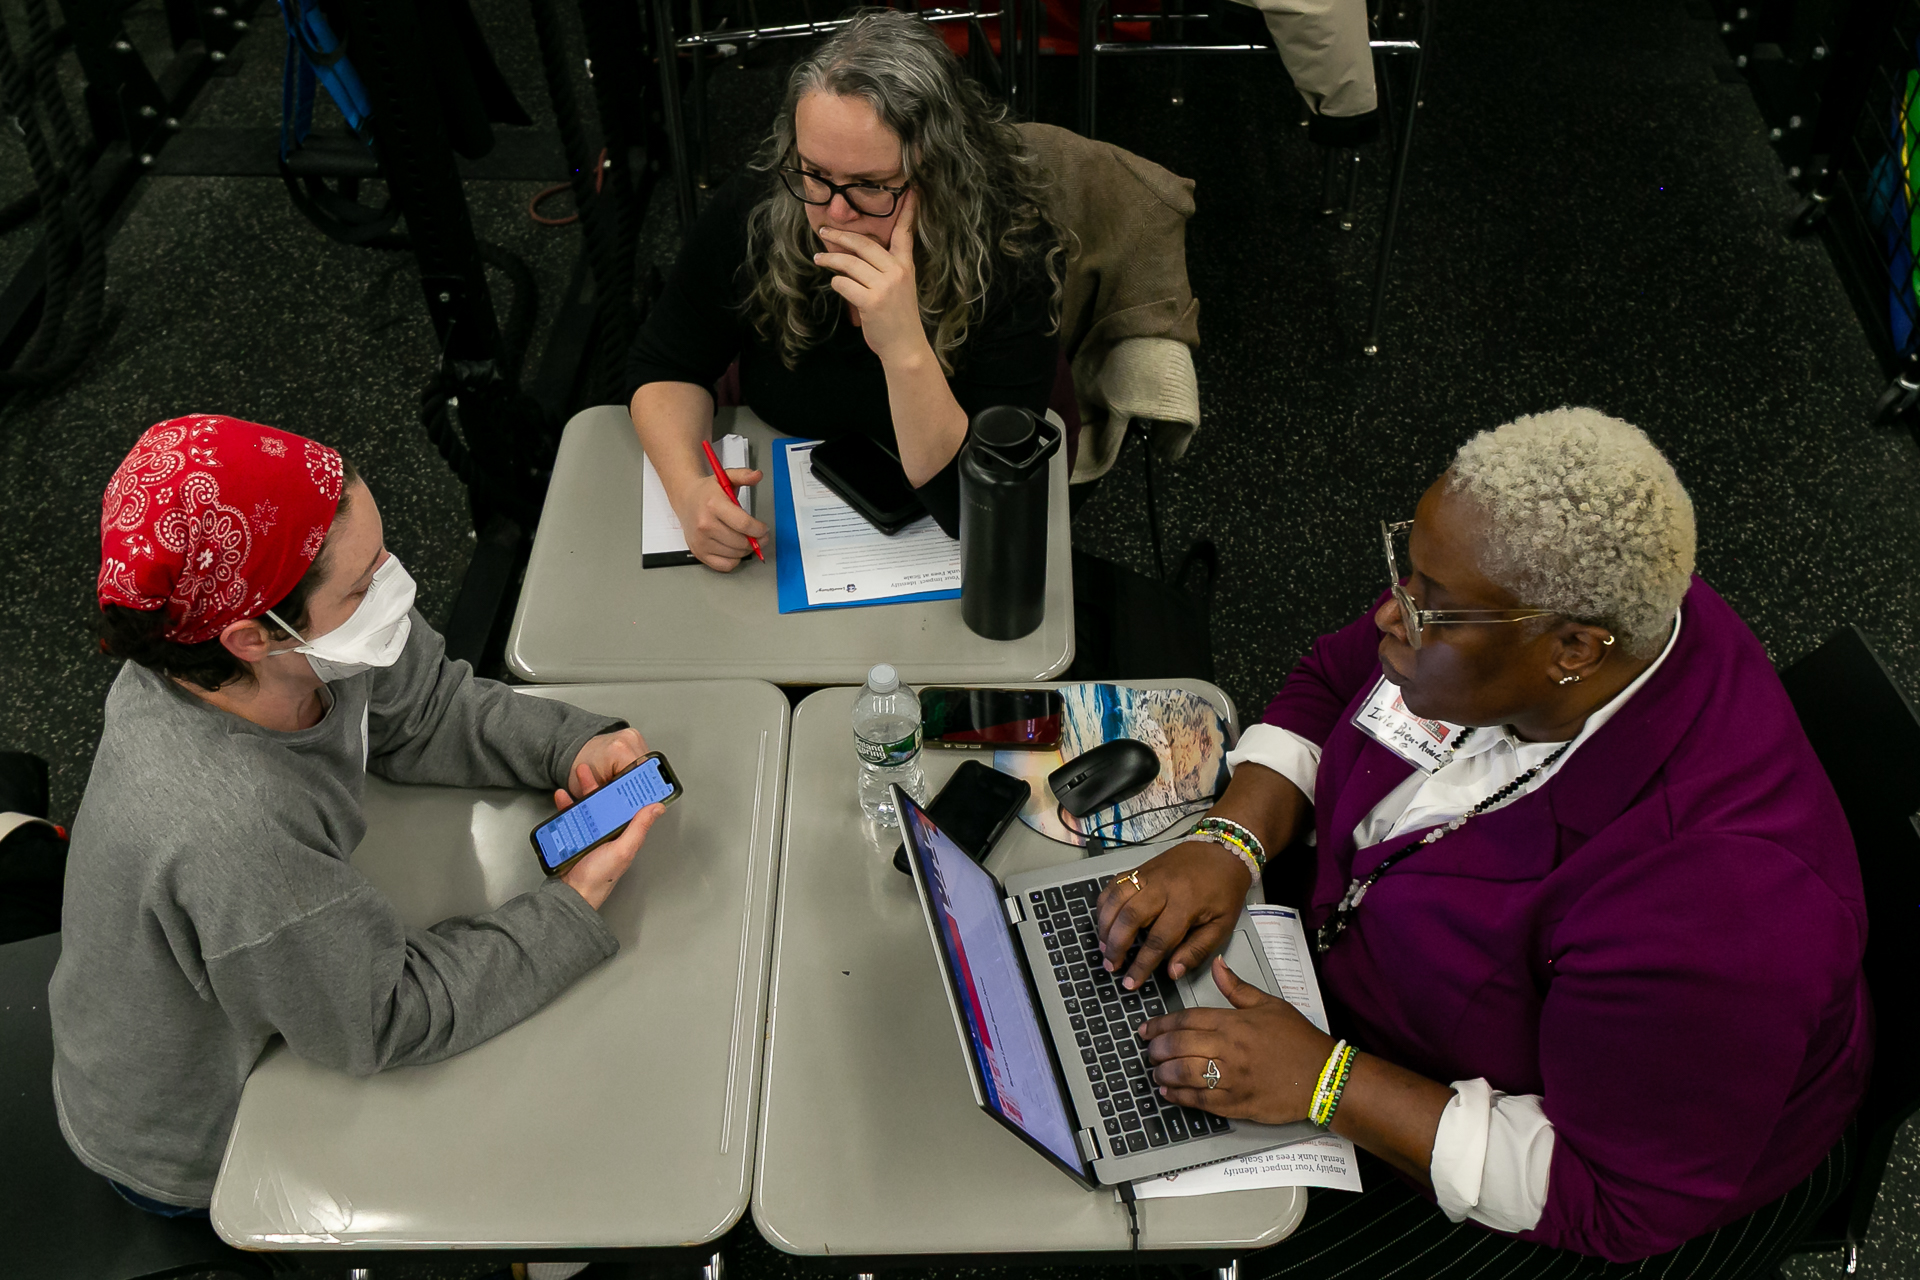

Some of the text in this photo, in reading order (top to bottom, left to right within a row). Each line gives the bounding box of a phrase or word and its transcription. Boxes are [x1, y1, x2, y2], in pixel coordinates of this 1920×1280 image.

[890, 580, 917, 588] Identify
[1239, 1156, 1263, 1165] Scale
[1276, 1153, 1296, 1162] Fees
[1298, 1153, 1319, 1163] Junk
[1320, 1154, 1345, 1165] Rental
[1223, 1166, 1258, 1177] Identify
[1294, 1163, 1315, 1172] Your
[1316, 1163, 1347, 1176] Amplify
